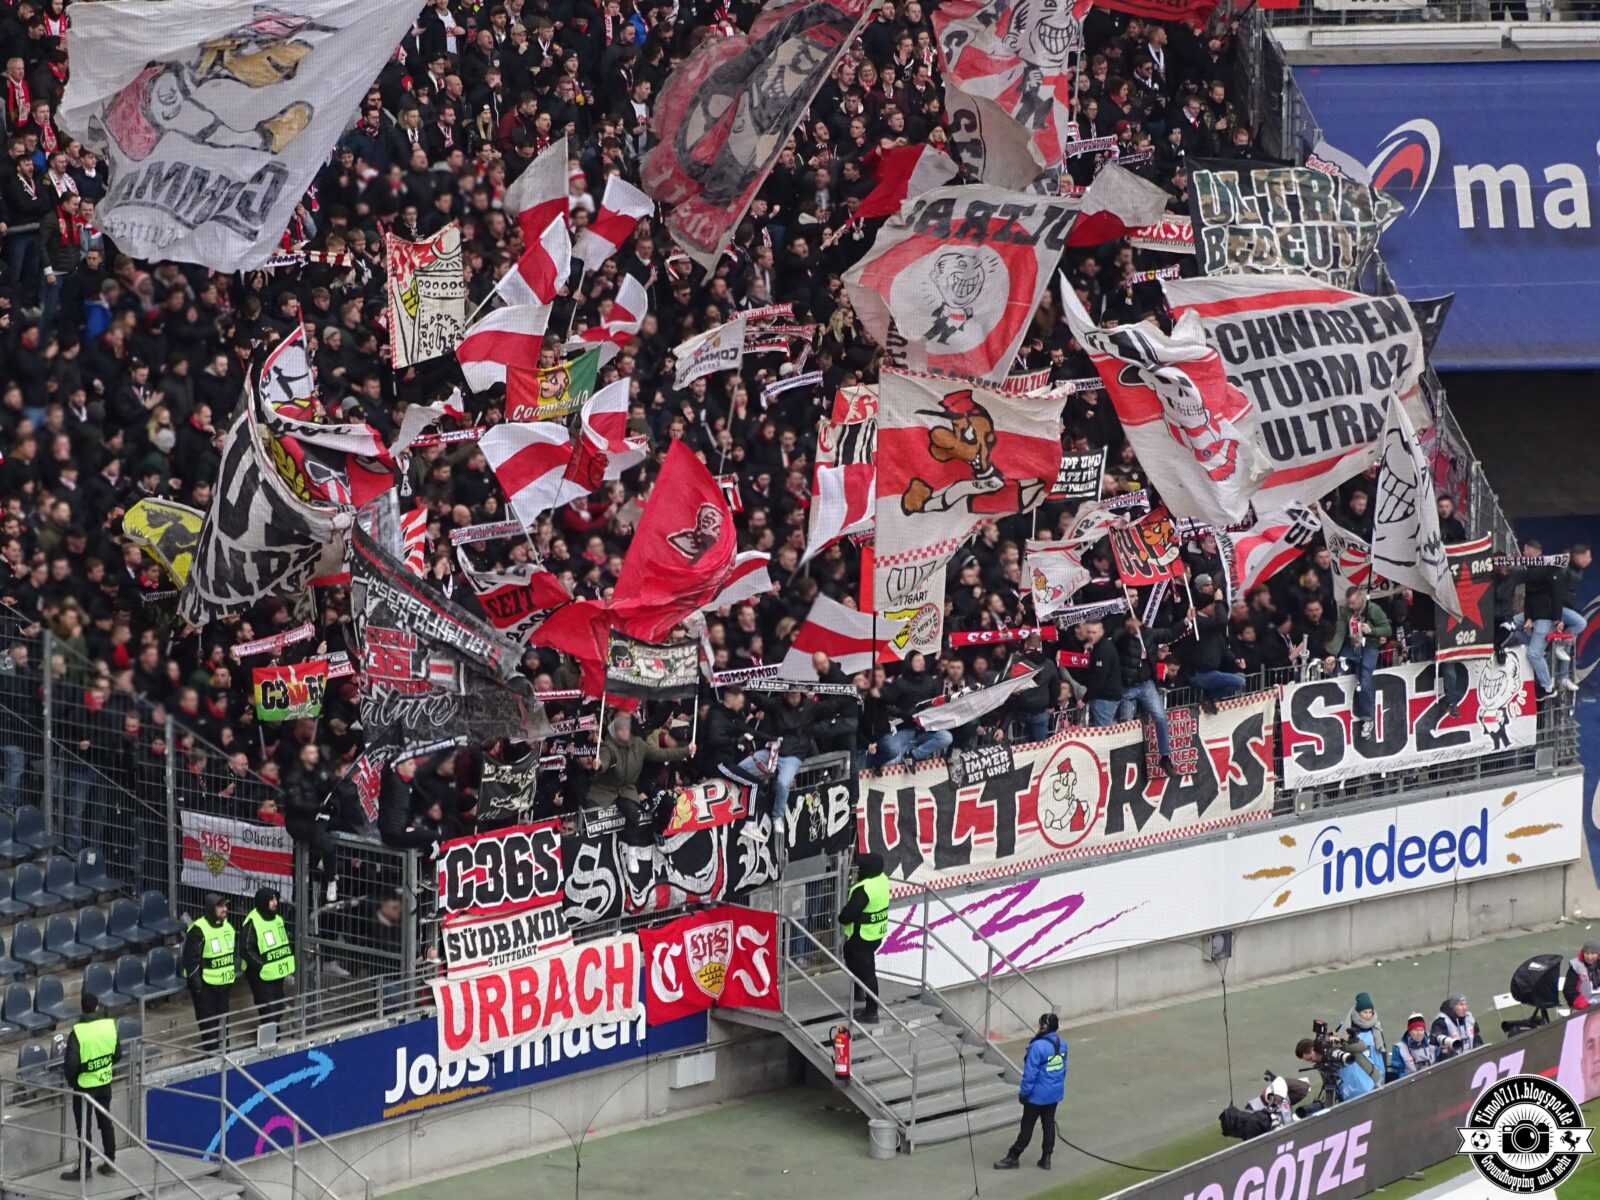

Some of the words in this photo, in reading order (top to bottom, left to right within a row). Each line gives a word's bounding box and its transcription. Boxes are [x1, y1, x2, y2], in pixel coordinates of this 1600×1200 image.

[1453, 160, 1600, 229] ma
[485, 588, 535, 618] SEIT
[1456, 629, 1477, 644] S02
[718, 666, 779, 684] COMMANDO
[1291, 661, 1472, 773] S02
[965, 750, 1009, 774] IMMER
[968, 771, 983, 783] BEI
[986, 761, 1011, 778] UNS!
[1294, 774, 1330, 788] Ultras
[1426, 744, 1487, 764] Stuttgart
[243, 828, 284, 849] Oberes
[1321, 807, 1489, 895] indeed
[446, 827, 561, 913] C36S
[487, 945, 538, 968] STUTTGART
[440, 942, 634, 1051] URBACH
[1232, 1119, 1373, 1200] GÖTZE
